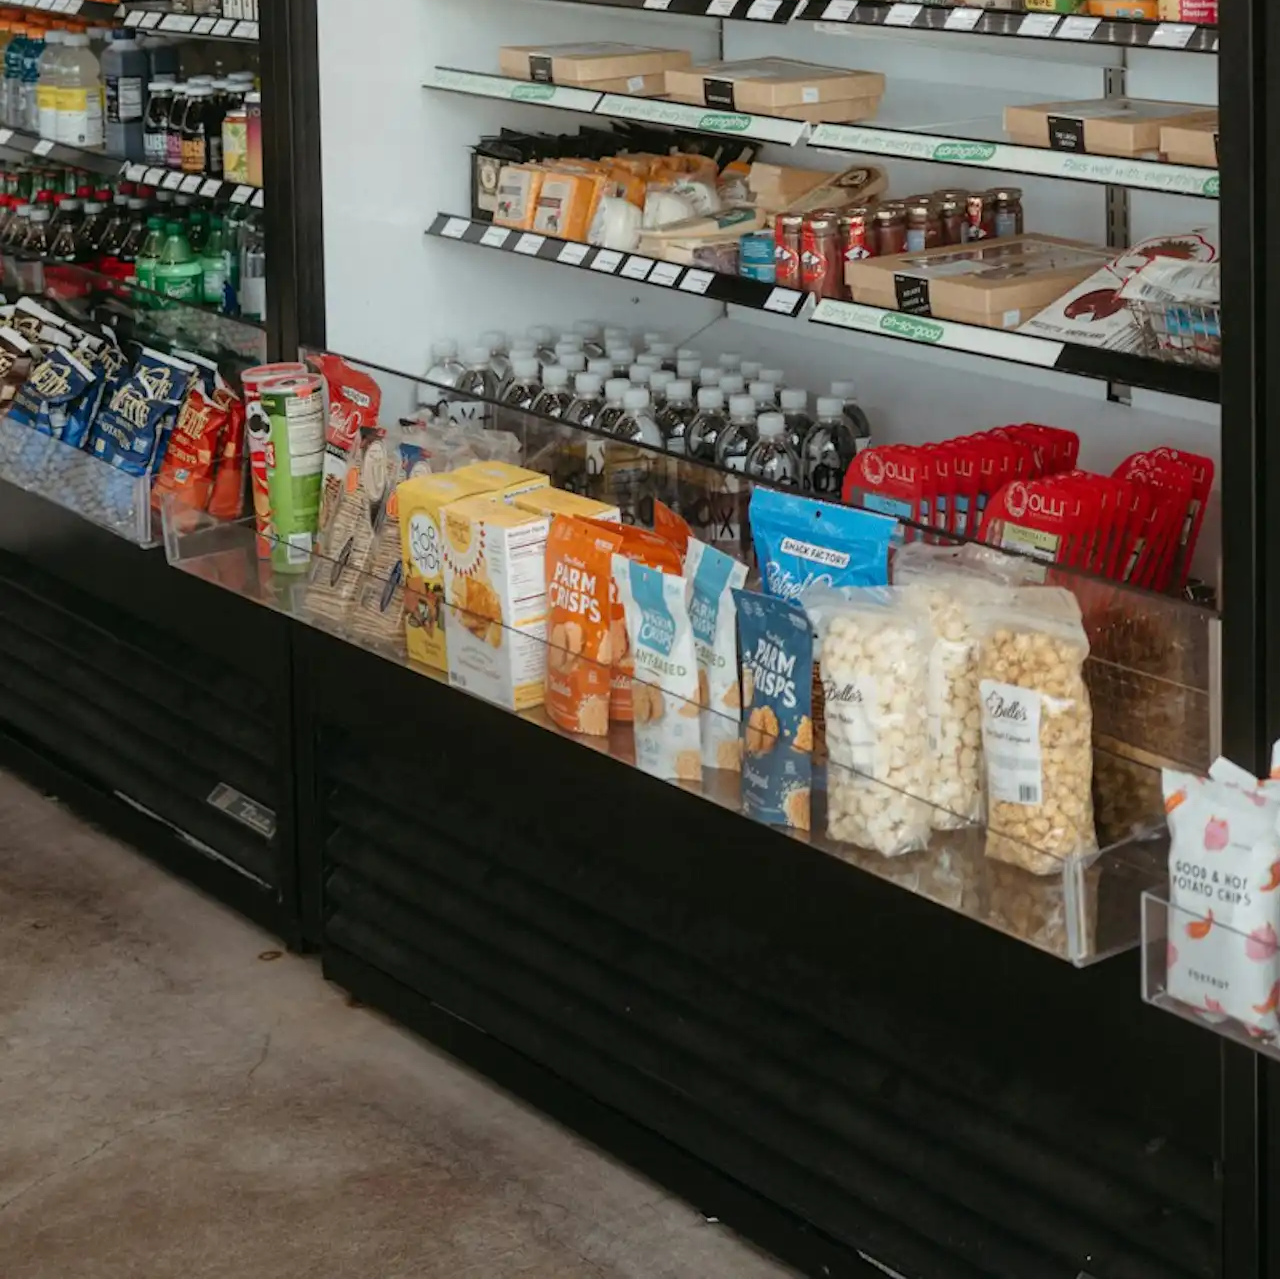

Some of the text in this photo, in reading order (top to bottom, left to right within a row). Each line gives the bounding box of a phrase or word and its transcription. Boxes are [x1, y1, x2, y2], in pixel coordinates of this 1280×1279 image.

[1027, 493, 1065, 517] OLLI
[784, 540, 848, 566] SNACK FACTORY
[554, 561, 597, 595] PARM
[549, 582, 601, 623] CRISPS
[755, 638, 797, 676] PARM
[1173, 874, 1252, 906] POTATO CHIPS
[1175, 860, 1249, 891] GOOD & HOT
